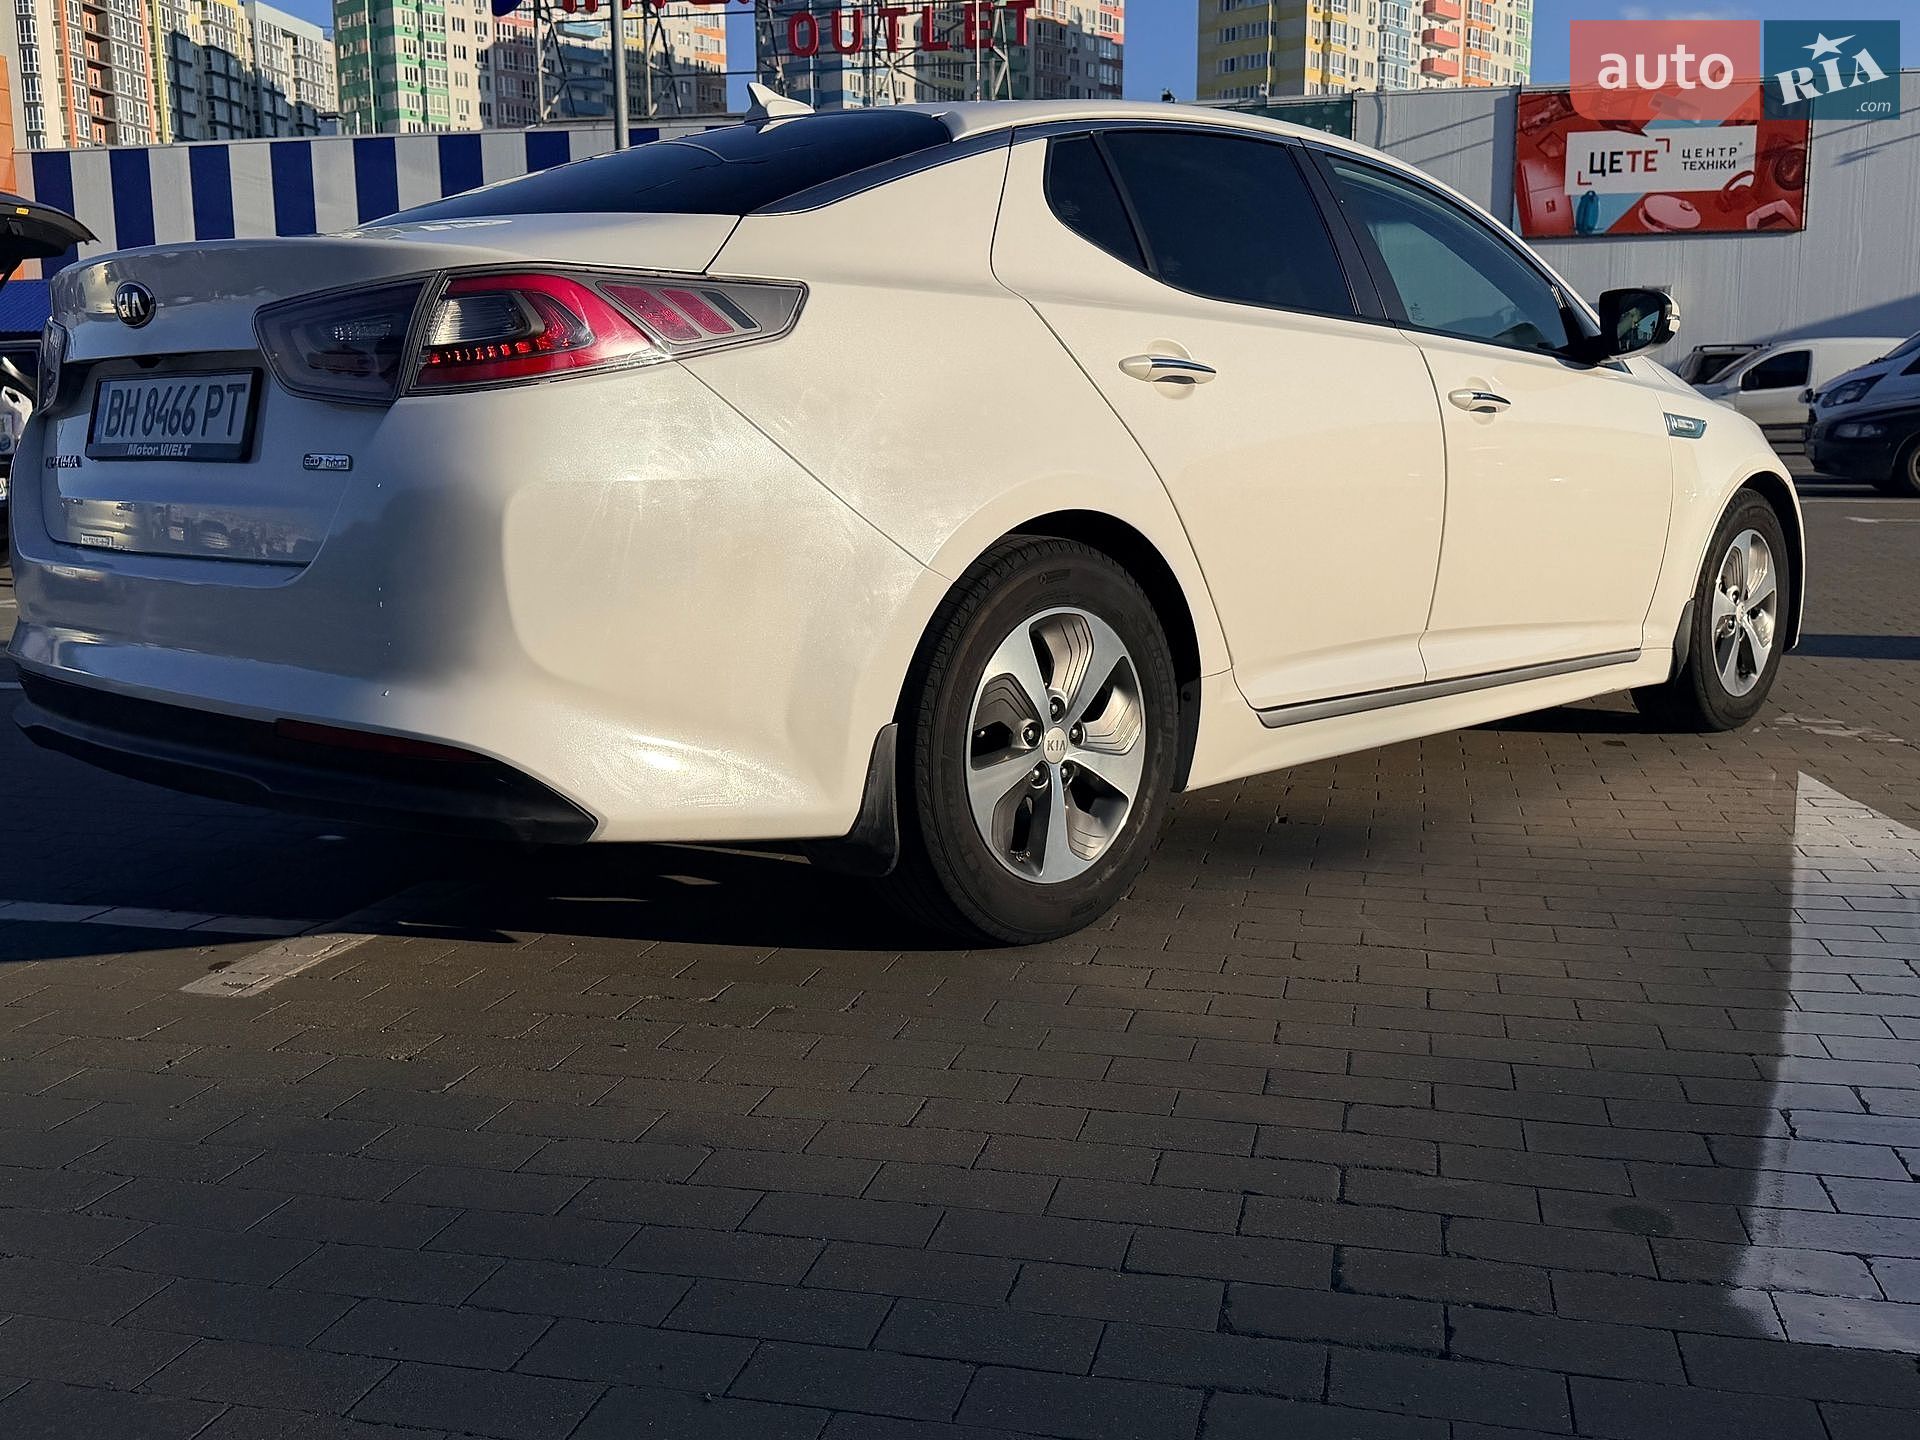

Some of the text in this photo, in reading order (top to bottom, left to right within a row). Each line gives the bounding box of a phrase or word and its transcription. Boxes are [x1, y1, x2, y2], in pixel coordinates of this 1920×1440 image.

[788, 1, 1034, 57] OUTLET
[1682, 147, 1738, 159] ЦЕНТР
[1589, 150, 1658, 177] ЦЕТЕ
[1682, 159, 1736, 171] ТЕХНІКИ
[104, 383, 246, 437] BH 8466 PT
[127, 444, 191, 456] Motor WELT
[1047, 740, 1066, 751] KIA
